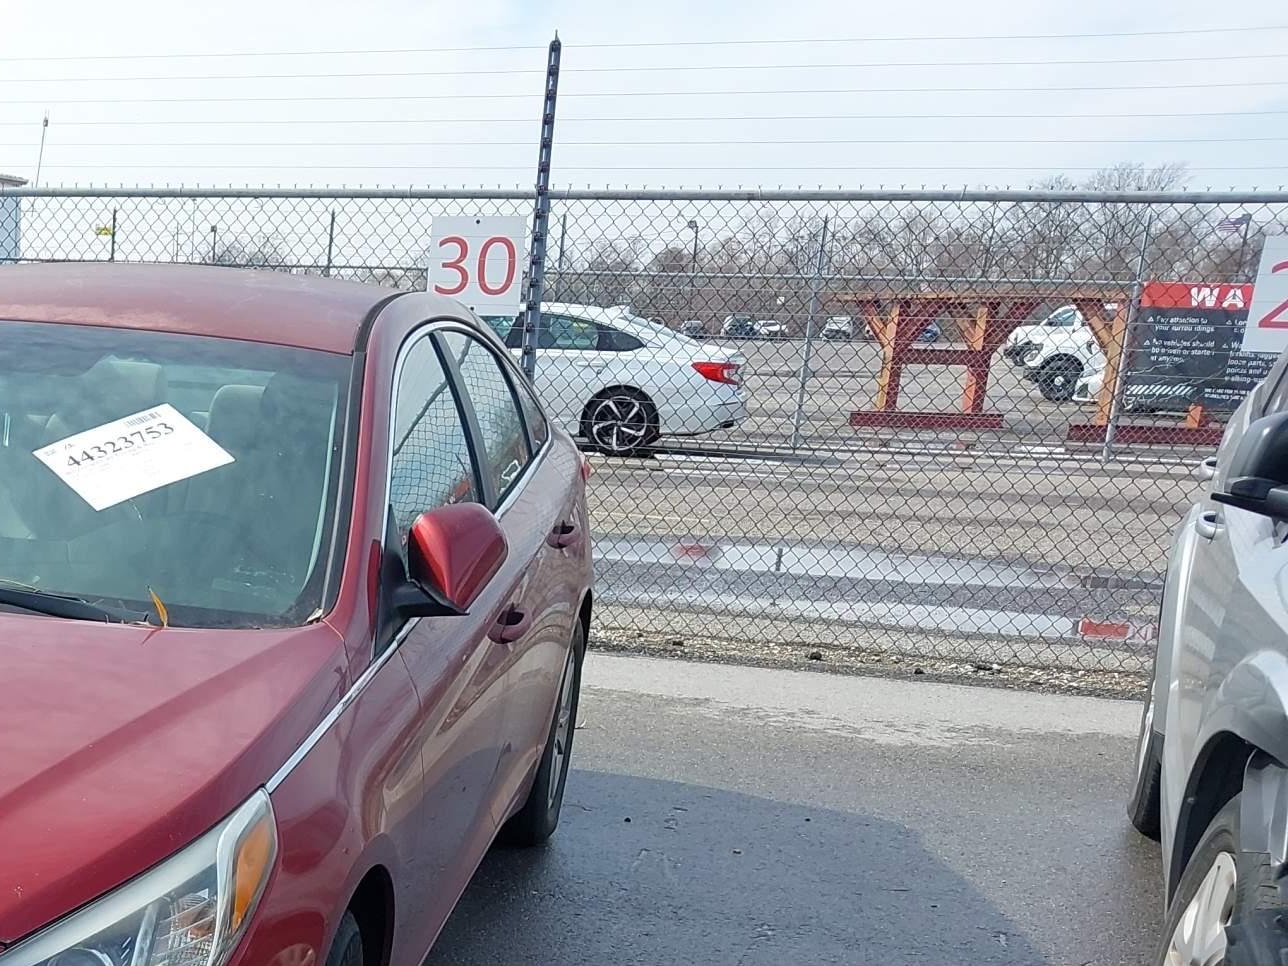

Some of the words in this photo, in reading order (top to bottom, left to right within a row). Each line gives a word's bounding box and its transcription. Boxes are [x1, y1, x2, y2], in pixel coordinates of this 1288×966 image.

[434, 236, 516, 296] 30
[1190, 286, 1245, 308] WA
[1257, 260, 1288, 329] 2
[66, 421, 175, 468] 44323753
